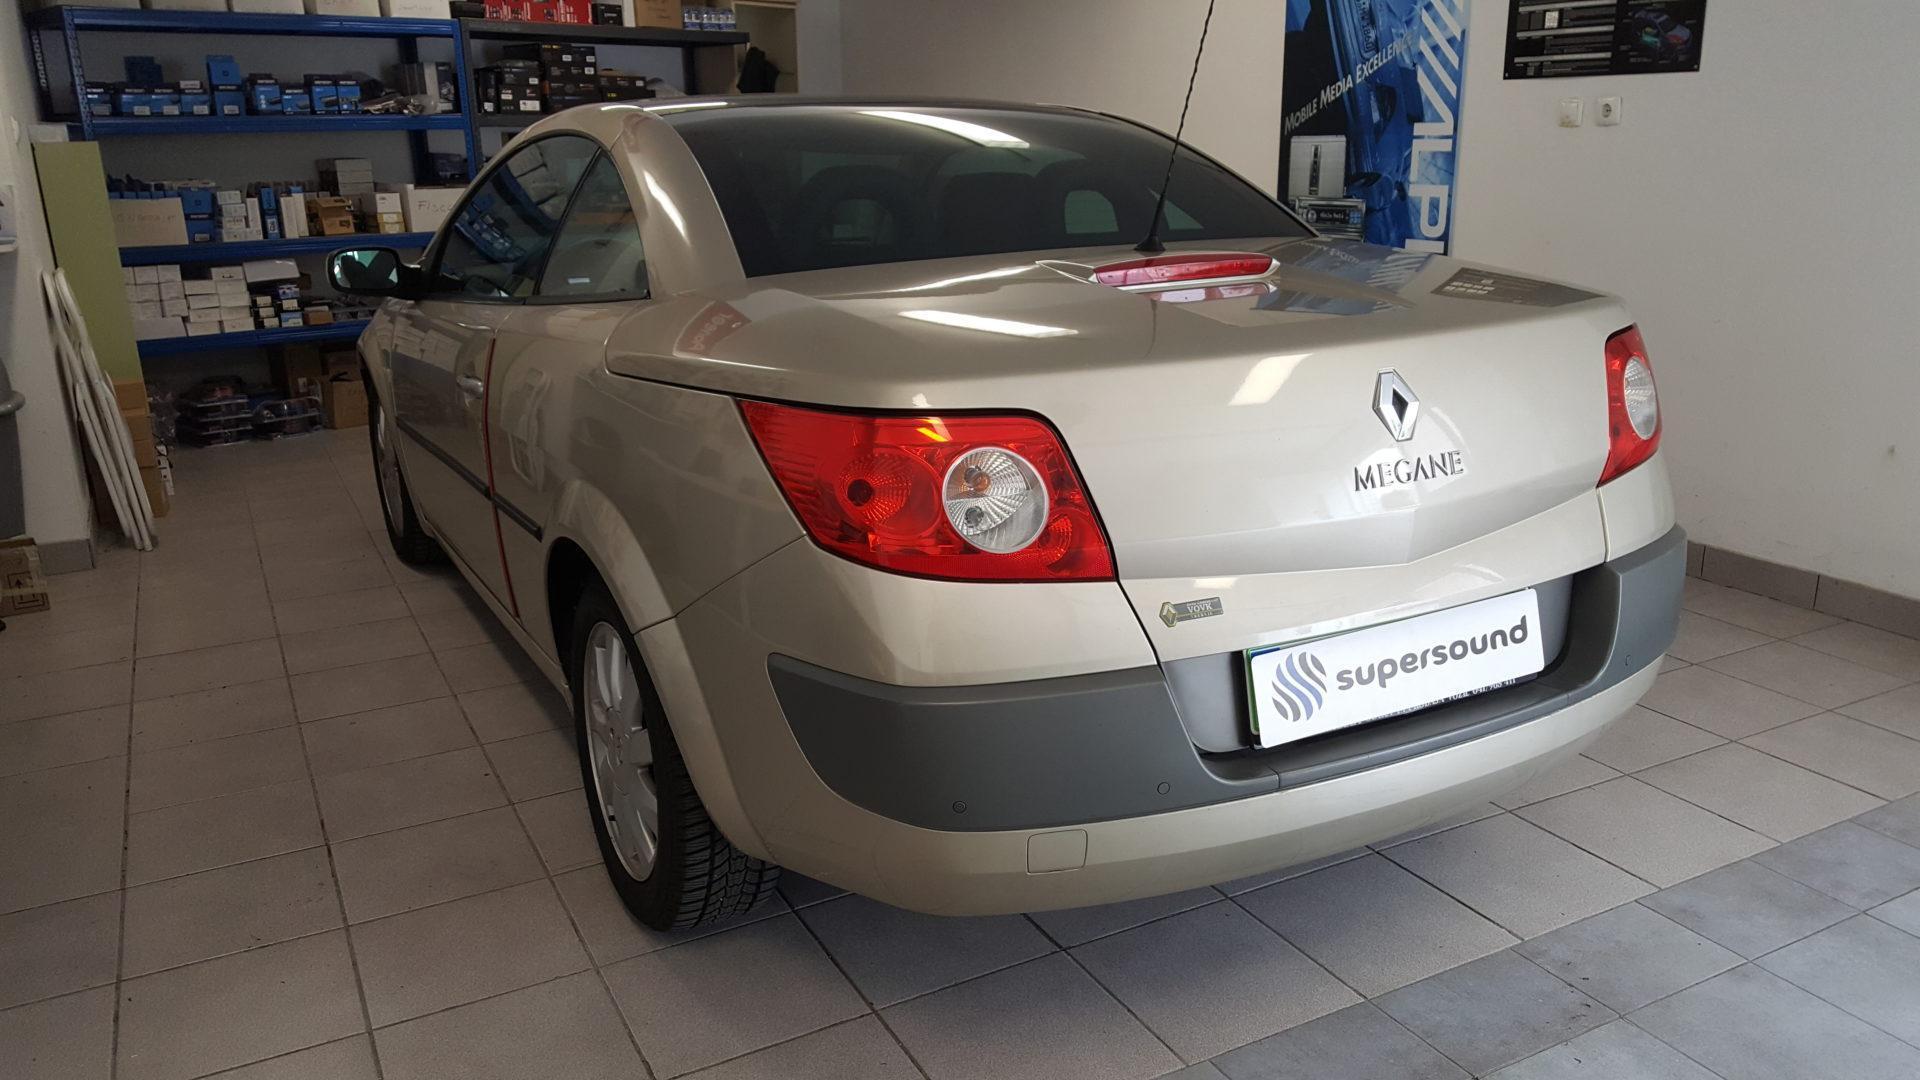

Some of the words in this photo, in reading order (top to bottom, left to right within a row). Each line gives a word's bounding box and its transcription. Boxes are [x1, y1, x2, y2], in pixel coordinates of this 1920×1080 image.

[1284, 98, 1317, 135] MOBILE
[1320, 74, 1353, 109] MEDIA
[1354, 451, 1464, 492] MEGANE
[1337, 614, 1529, 691] supersound
